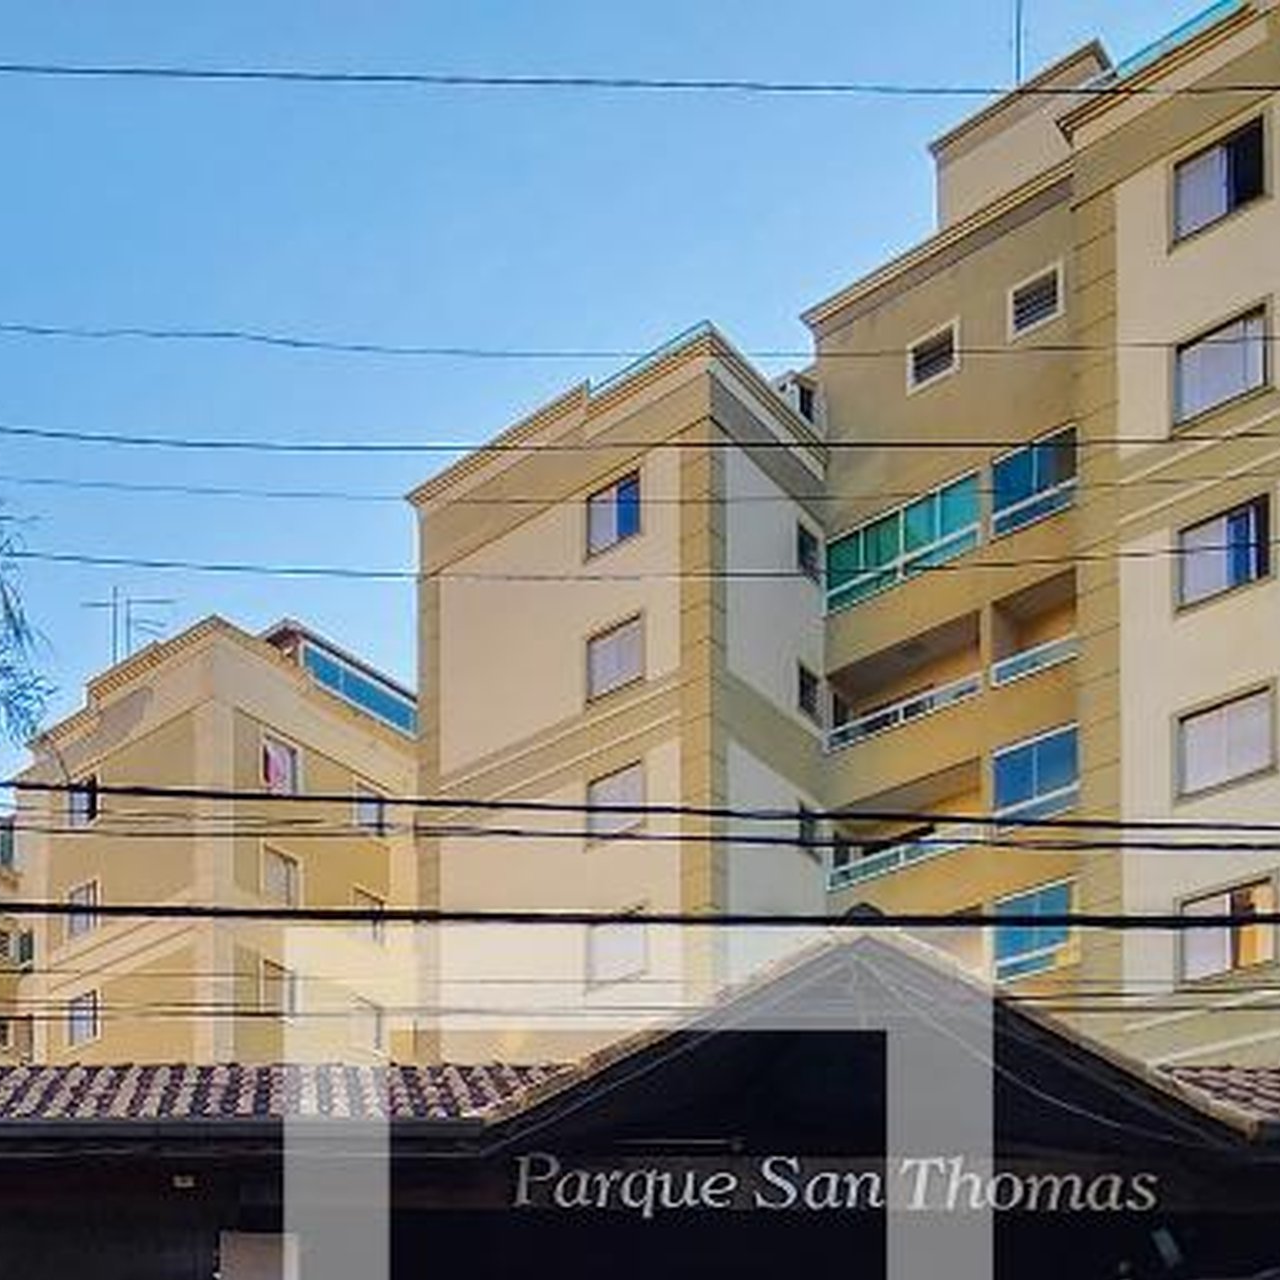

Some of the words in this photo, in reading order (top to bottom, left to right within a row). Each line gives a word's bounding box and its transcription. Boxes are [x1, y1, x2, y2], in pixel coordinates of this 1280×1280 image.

[513, 1153, 739, 1218] Parque
[753, 1155, 884, 1211] San
[897, 1155, 1159, 1212] Thomas
